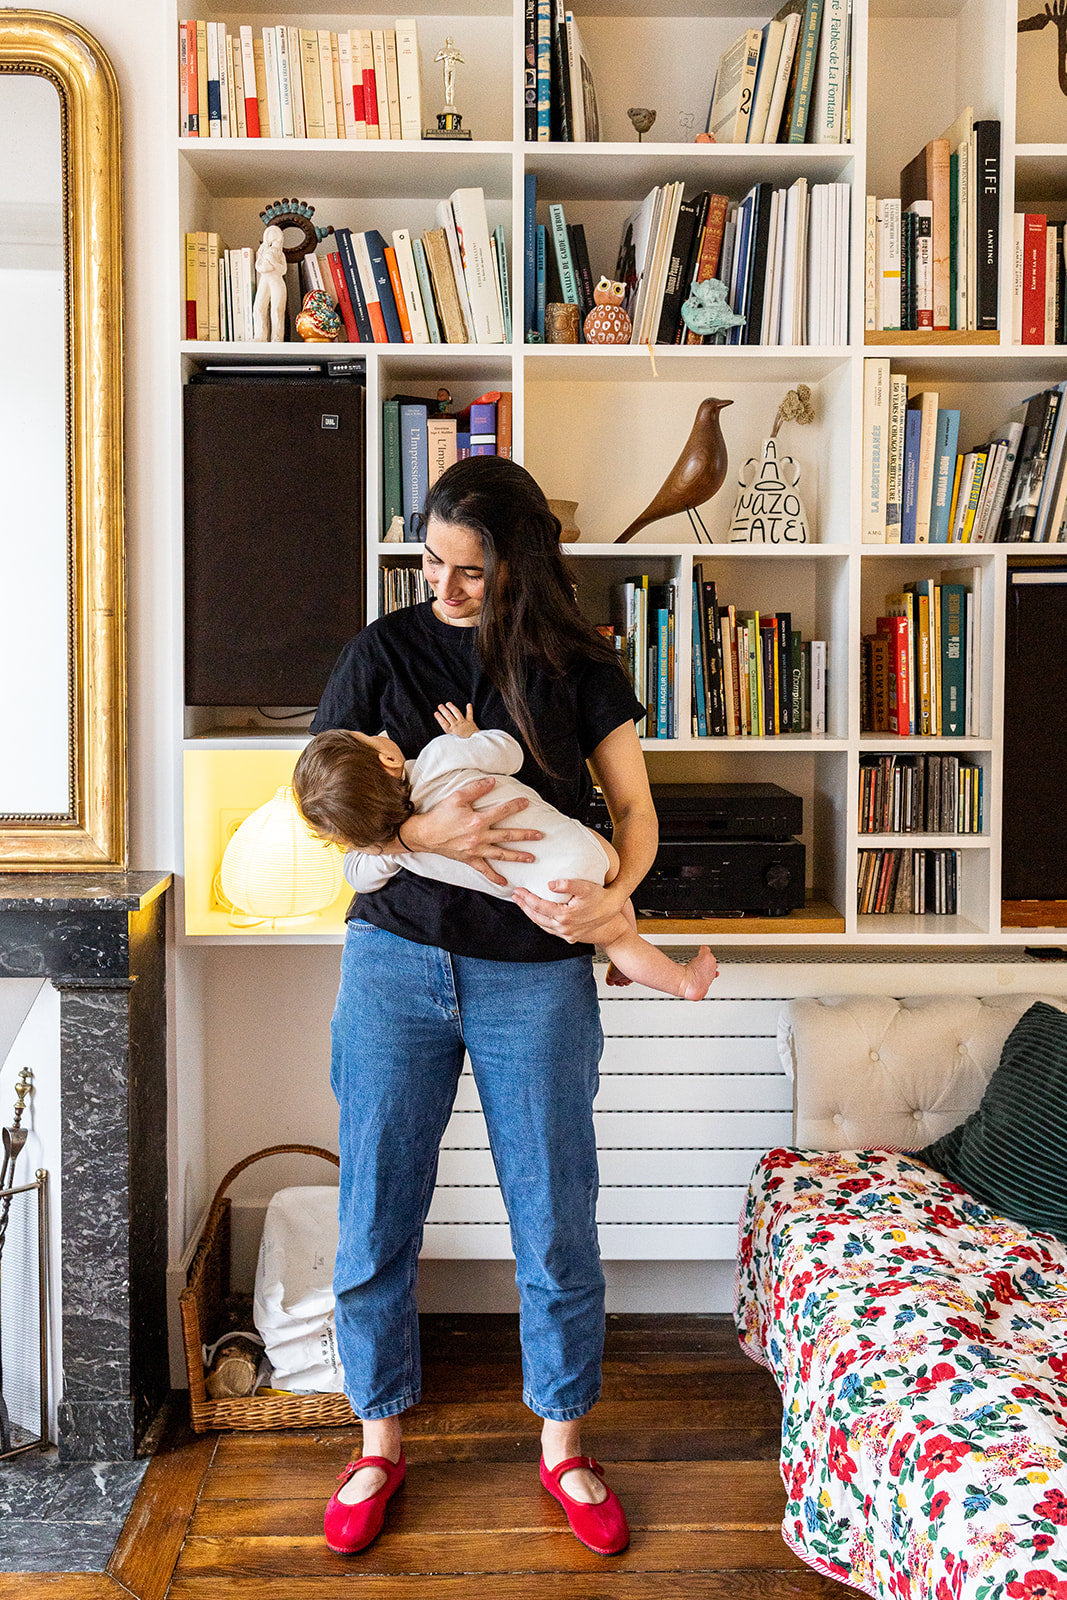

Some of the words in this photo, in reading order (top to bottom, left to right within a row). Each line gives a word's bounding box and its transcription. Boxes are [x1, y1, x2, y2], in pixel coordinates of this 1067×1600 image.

[809, 12, 817, 31] GRAND
[807, 33, 815, 48] LIVRE
[830, 18, 841, 50] Fables
[829, 52, 839, 64] de
[801, 51, 812, 92] INTERNATIONAL
[829, 66, 839, 79] La
[739, 88, 751, 115] 2
[827, 83, 838, 129] Fontaine
[984, 158, 997, 194] LIFE
[559, 239, 567, 259] GARDE
[562, 260, 570, 269] DE
[563, 271, 573, 292] SALLES
[566, 293, 574, 303] DE
[892, 415, 898, 423] OF
[925, 400, 934, 425] peintres
[890, 425, 898, 452] CHICAGO
[870, 425, 881, 500] MÉDITERRANÉE
[938, 455, 950, 476] NOUS
[889, 453, 897, 501] ARCHITECTURE
[972, 463, 984, 484] ALASKA
[936, 476, 948, 507] VIVRONS
[970, 484, 980, 500] ES-TU
[871, 501, 879, 513] LA
[968, 501, 977, 510] QUI
